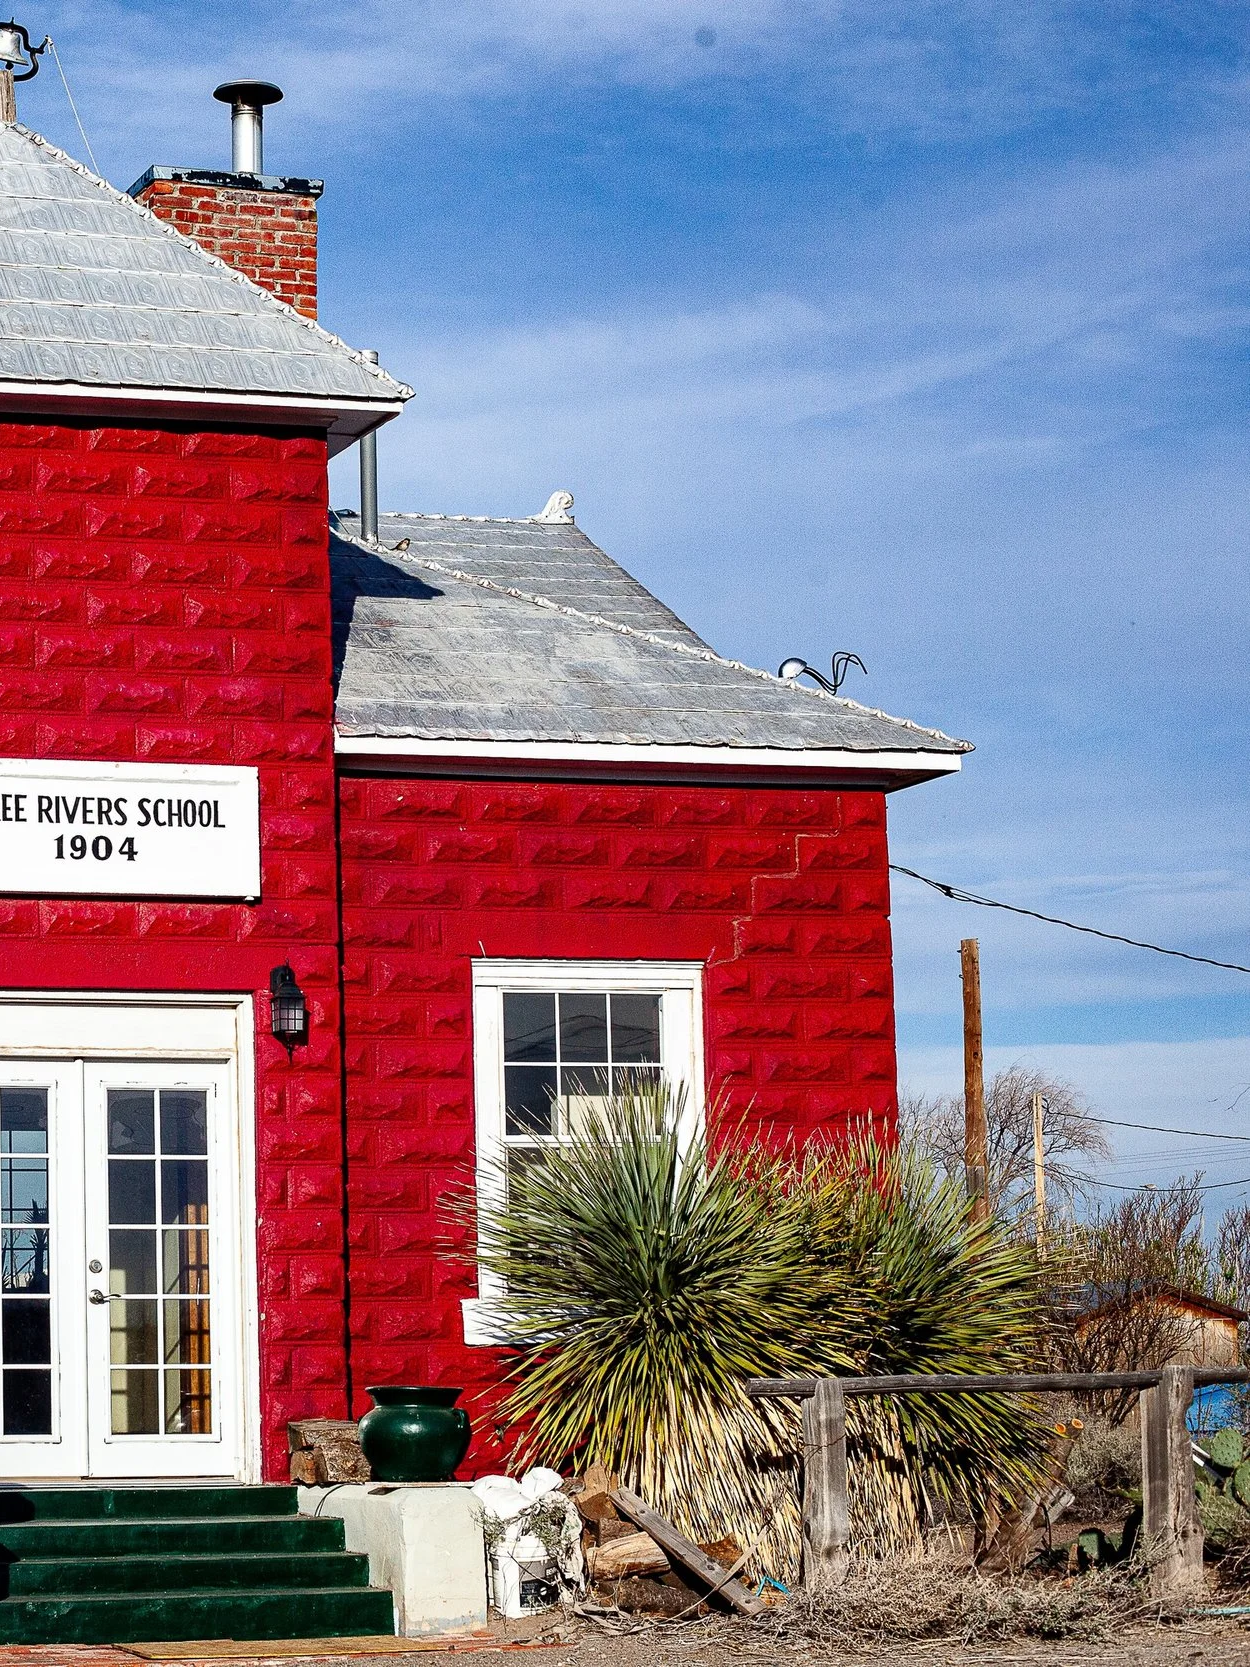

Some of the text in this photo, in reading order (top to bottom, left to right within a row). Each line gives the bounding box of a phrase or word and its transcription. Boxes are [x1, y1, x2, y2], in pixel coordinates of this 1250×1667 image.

[37, 796, 128, 825] RIVERS
[136, 798, 226, 828] SCHOOL
[54, 834, 139, 861] 1904
